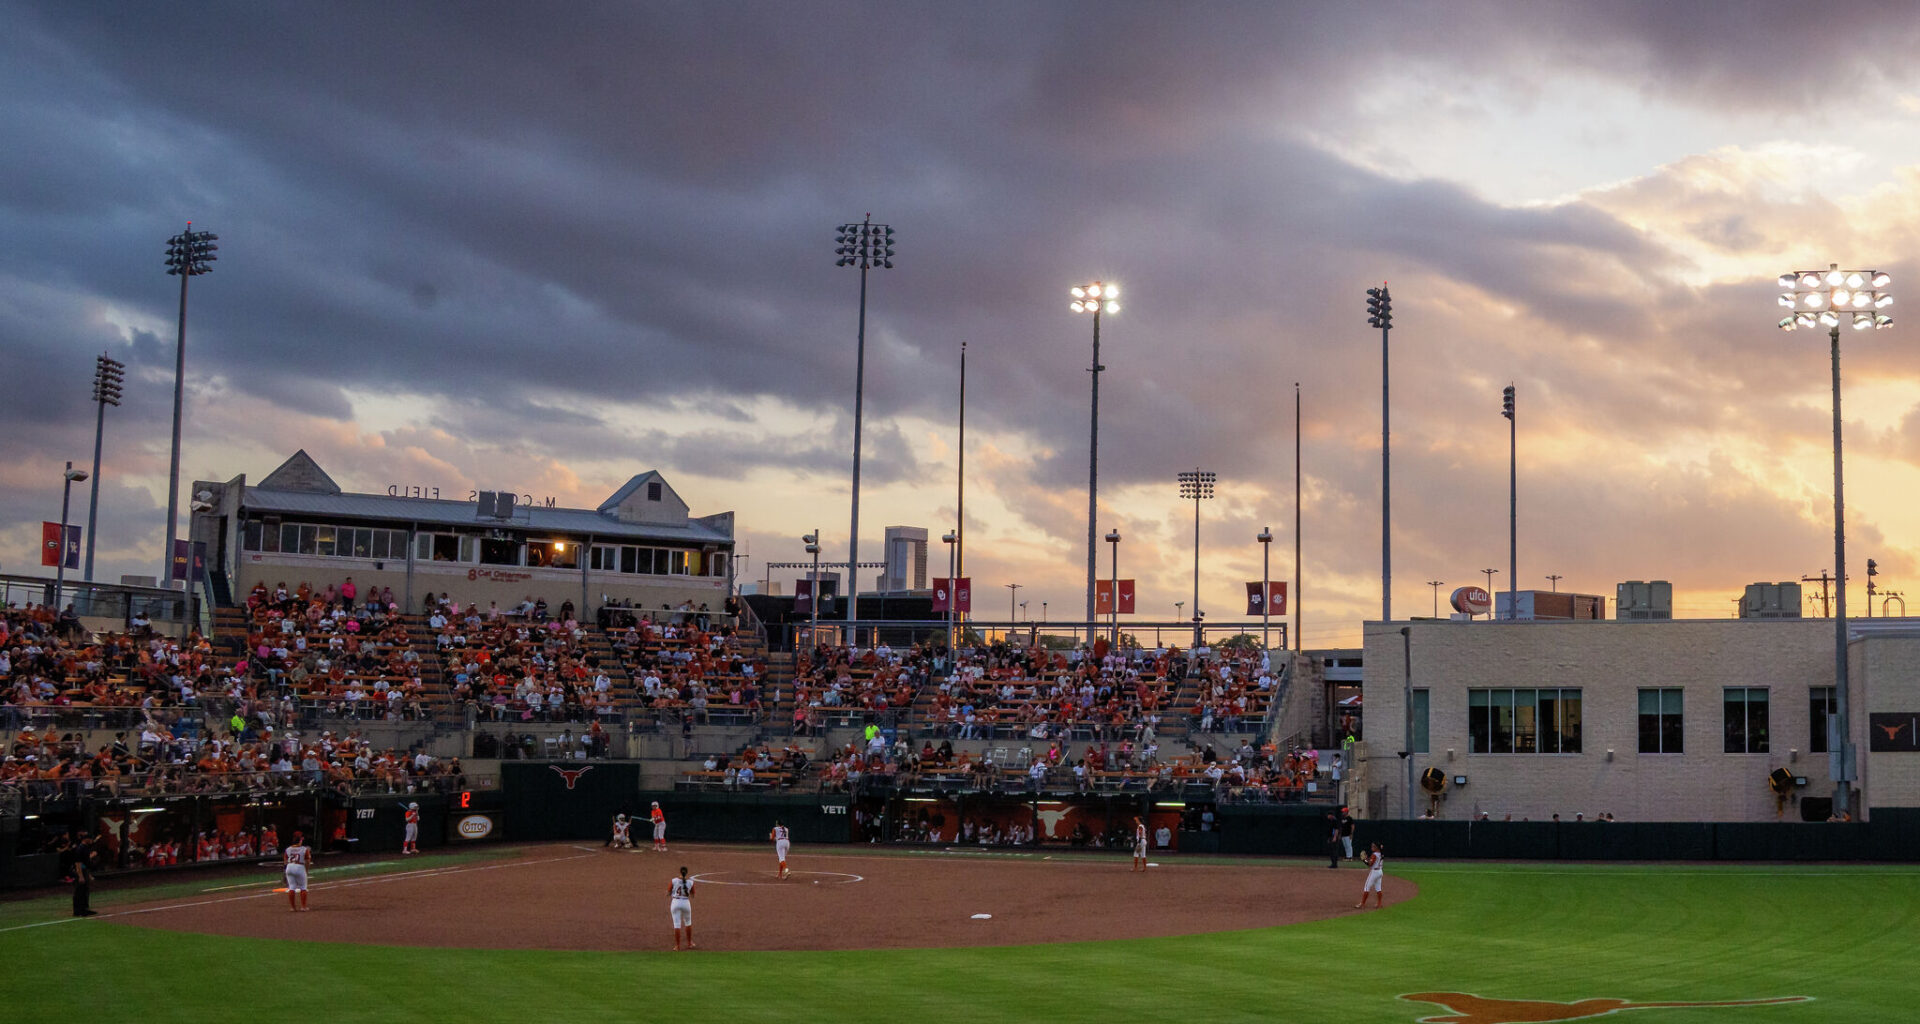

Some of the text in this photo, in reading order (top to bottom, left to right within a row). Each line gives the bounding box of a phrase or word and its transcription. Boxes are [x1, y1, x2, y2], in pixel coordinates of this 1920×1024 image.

[468, 569, 477, 581] 8
[1470, 589, 1487, 601] ufcu
[356, 808, 375, 819] YETI
[821, 805, 847, 815] YETI
